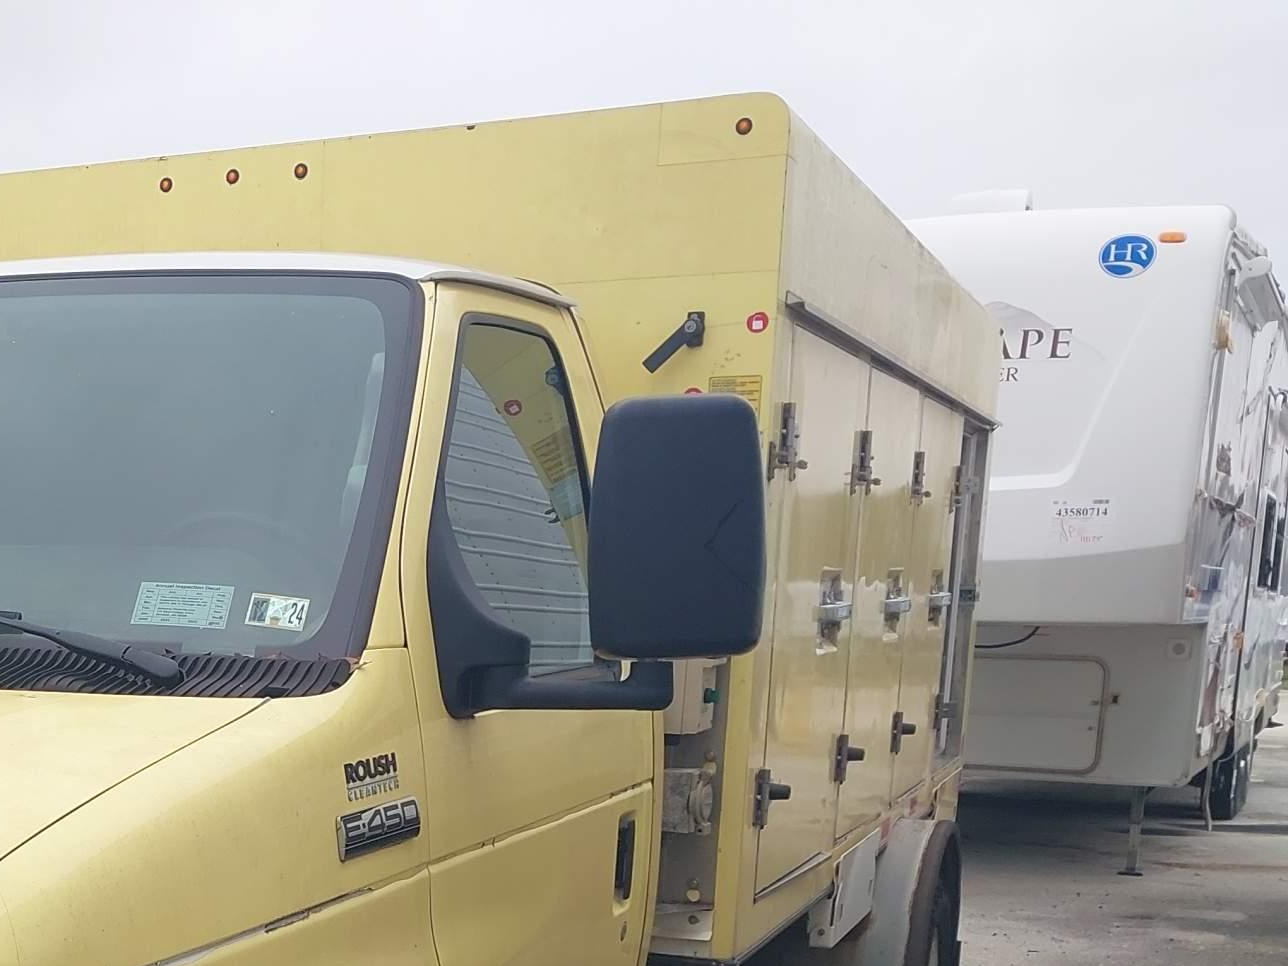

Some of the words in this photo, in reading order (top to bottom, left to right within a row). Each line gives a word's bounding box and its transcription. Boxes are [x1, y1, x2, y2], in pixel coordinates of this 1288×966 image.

[1108, 242, 1148, 262] HR
[1055, 506, 1108, 518] 43580714
[288, 602, 306, 625] 24
[343, 752, 398, 784] ROUSH
[347, 779, 400, 802] CLEANTECH
